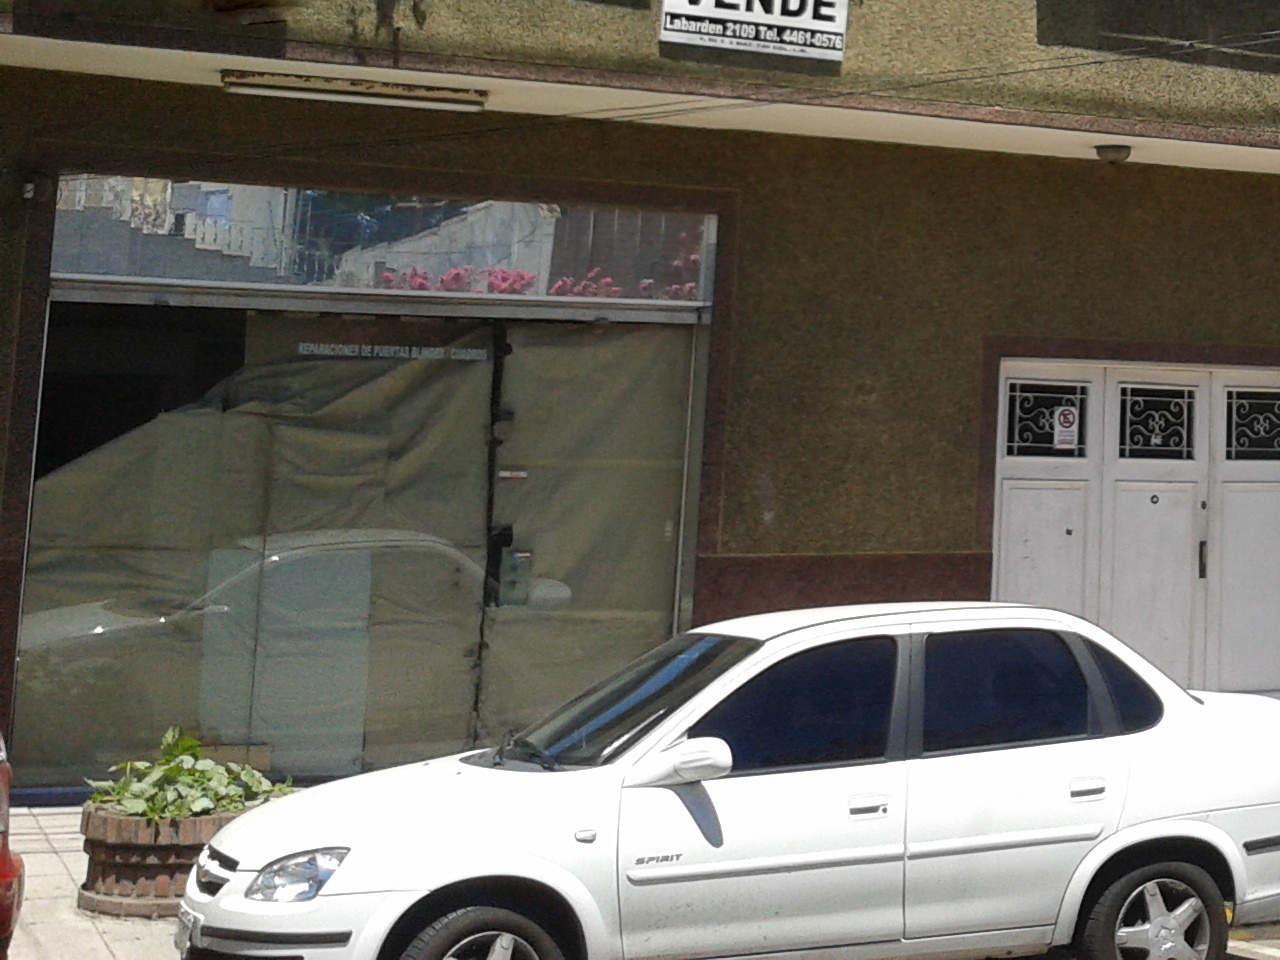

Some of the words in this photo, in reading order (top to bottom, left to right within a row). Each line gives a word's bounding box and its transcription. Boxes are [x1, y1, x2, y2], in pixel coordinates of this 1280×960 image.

[665, 14, 724, 36] Labarden
[725, 22, 756, 39] 2109
[634, 853, 683, 866] SPIRIT
